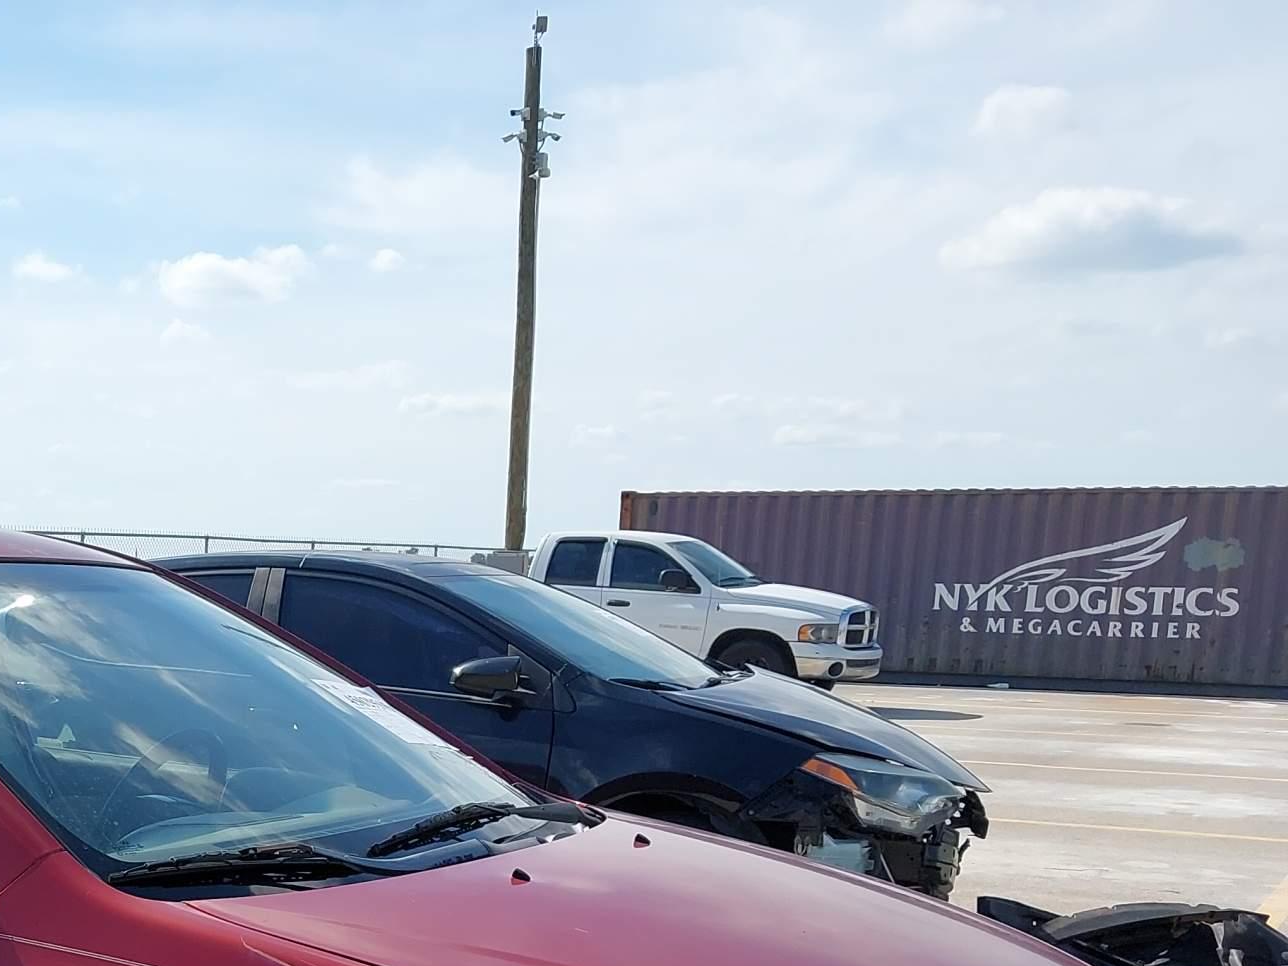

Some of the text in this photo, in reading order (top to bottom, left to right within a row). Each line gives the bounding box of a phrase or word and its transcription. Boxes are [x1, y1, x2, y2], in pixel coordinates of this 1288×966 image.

[932, 583, 1240, 617] NYK LOGISTICS
[959, 617, 1201, 639] & MEGACARRIER
